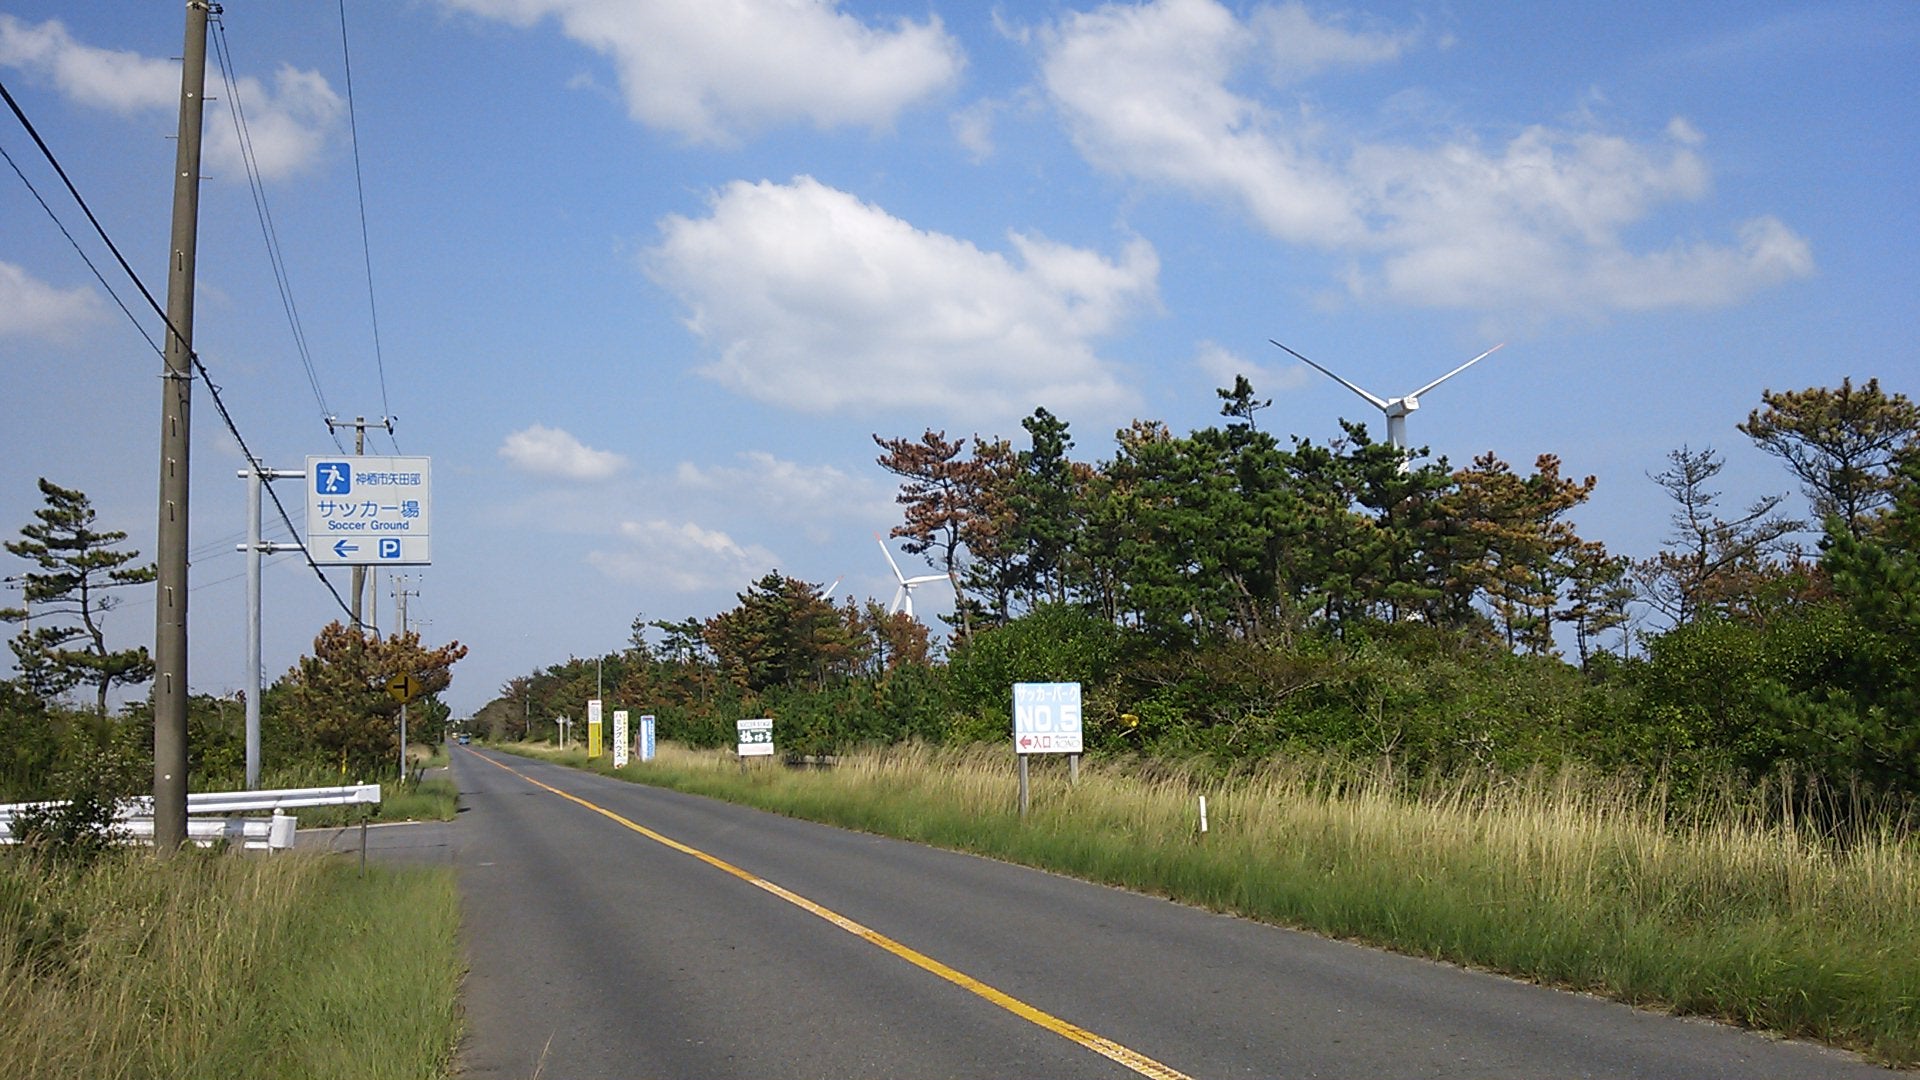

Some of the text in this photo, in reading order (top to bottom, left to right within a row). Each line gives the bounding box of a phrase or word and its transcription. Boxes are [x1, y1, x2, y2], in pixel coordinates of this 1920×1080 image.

[355, 473, 421, 486] 神栖市矢田部
[317, 500, 420, 518] サッカー場
[328, 520, 409, 530] Soccer Ground
[382, 540, 397, 557] P
[1018, 704, 1078, 732] NO.5
[1033, 736, 1051, 749] 入口
